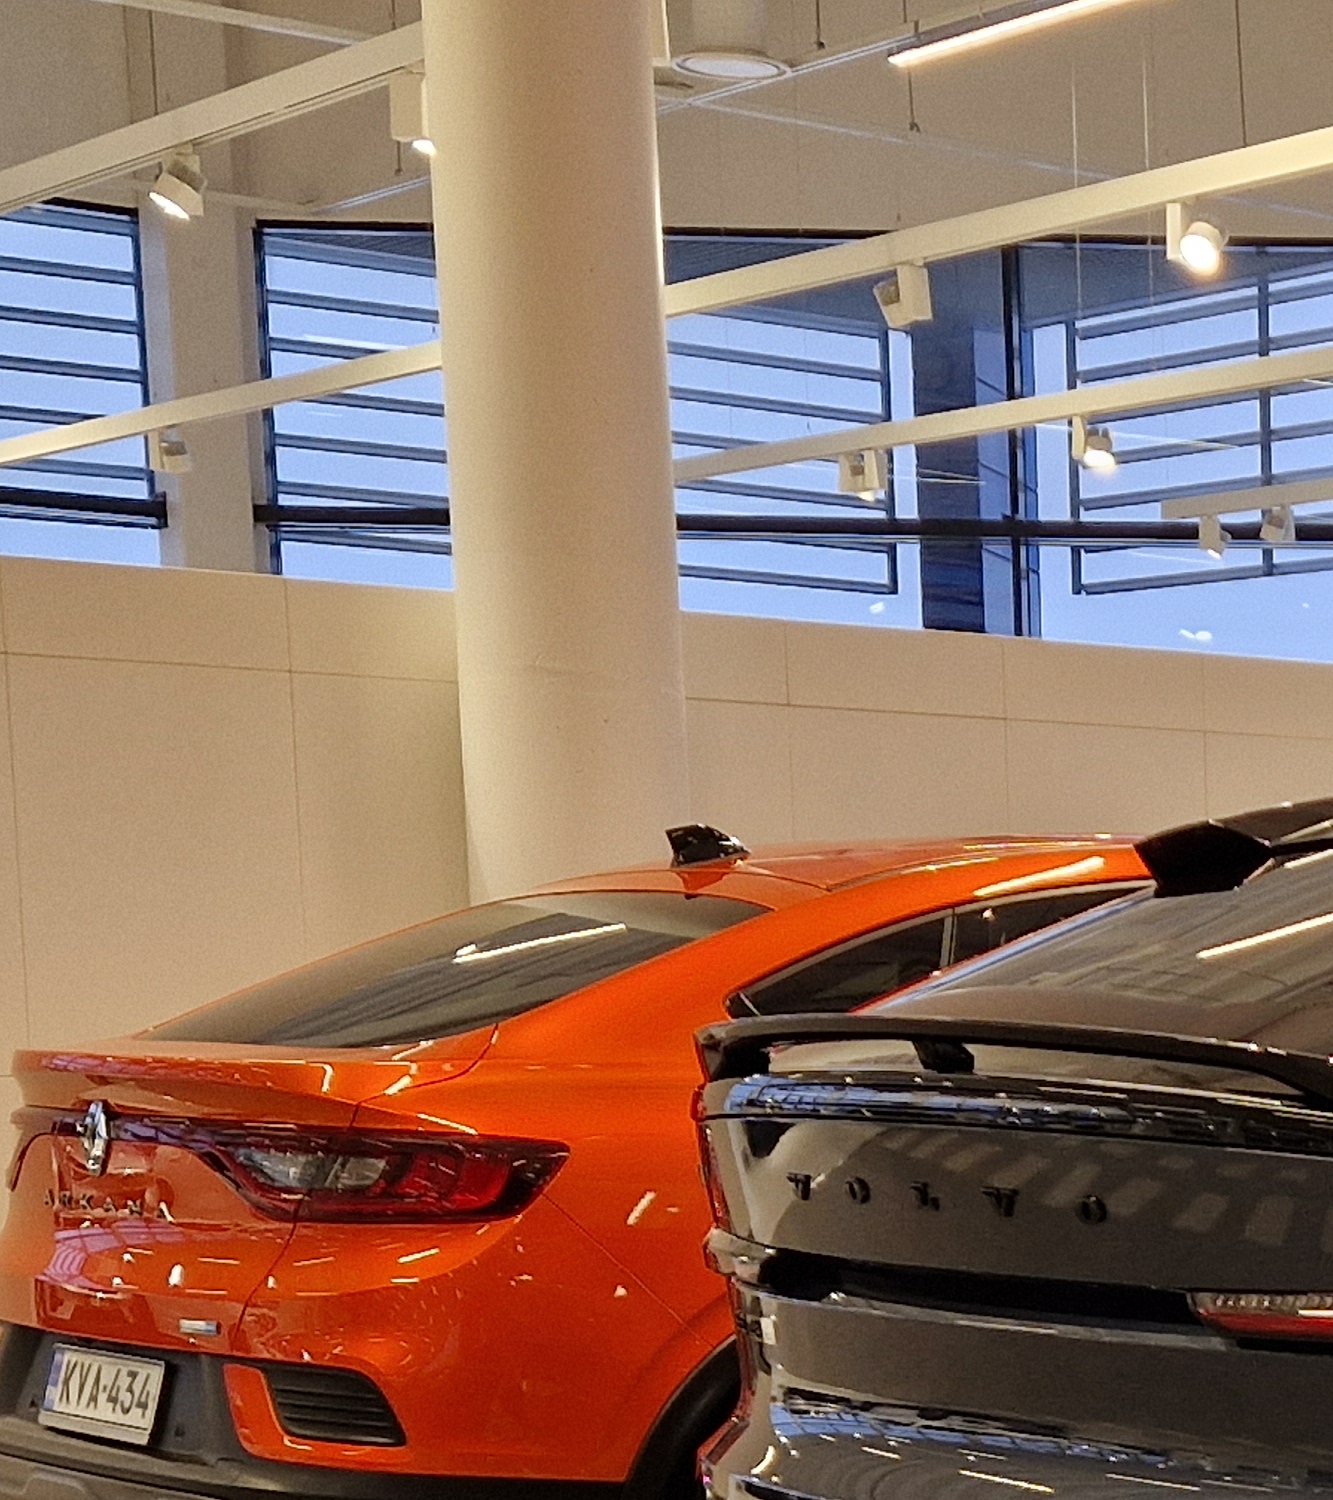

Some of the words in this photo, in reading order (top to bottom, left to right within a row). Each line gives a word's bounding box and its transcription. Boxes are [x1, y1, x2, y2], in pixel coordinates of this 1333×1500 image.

[43, 1187, 178, 1223] ARKANA
[786, 1172, 1108, 1225] VOLVO
[58, 1359, 151, 1420] KVA-434
